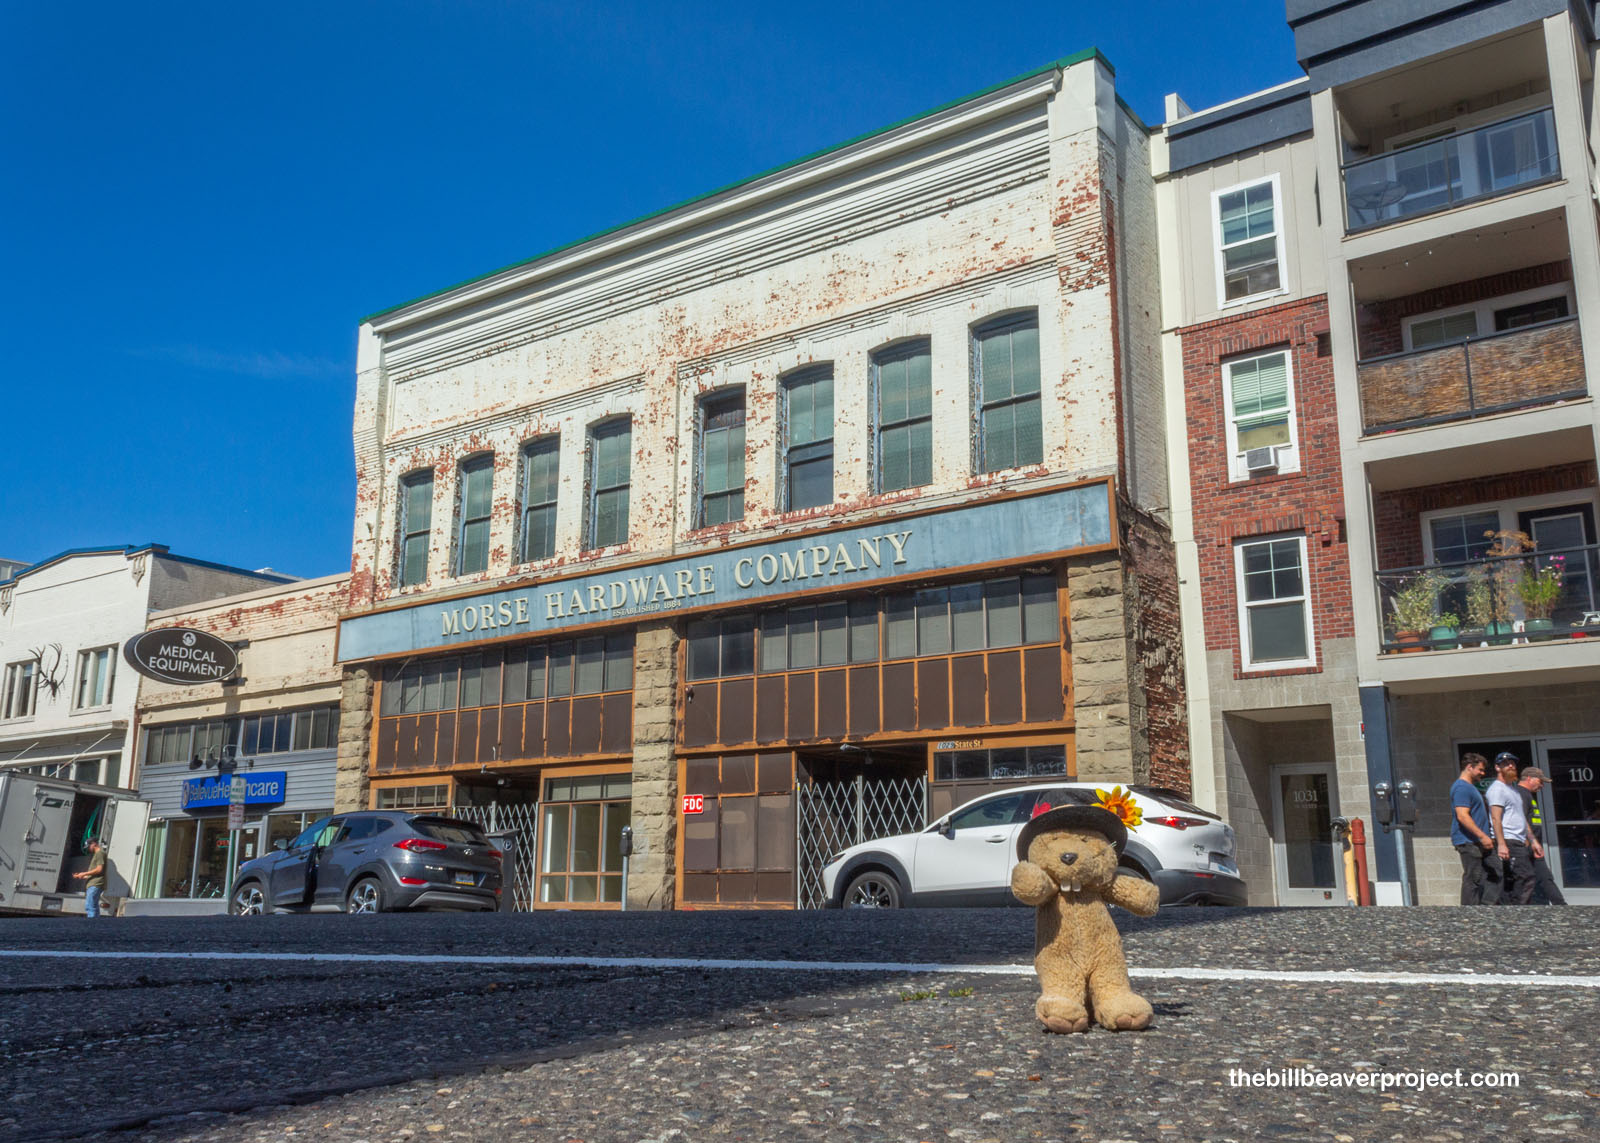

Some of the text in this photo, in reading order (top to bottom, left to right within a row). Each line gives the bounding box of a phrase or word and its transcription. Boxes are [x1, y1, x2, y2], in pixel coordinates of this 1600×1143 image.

[441, 530, 913, 636] MORSE HARDWARE COMPANY
[612, 603, 660, 617] ESTABLISHED
[159, 644, 217, 663] MEDICAL
[149, 656, 225, 677] EQUIPMENT
[1568, 767, 1594, 782] 110
[1294, 790, 1318, 802] 1031
[683, 798, 702, 810] FDC
